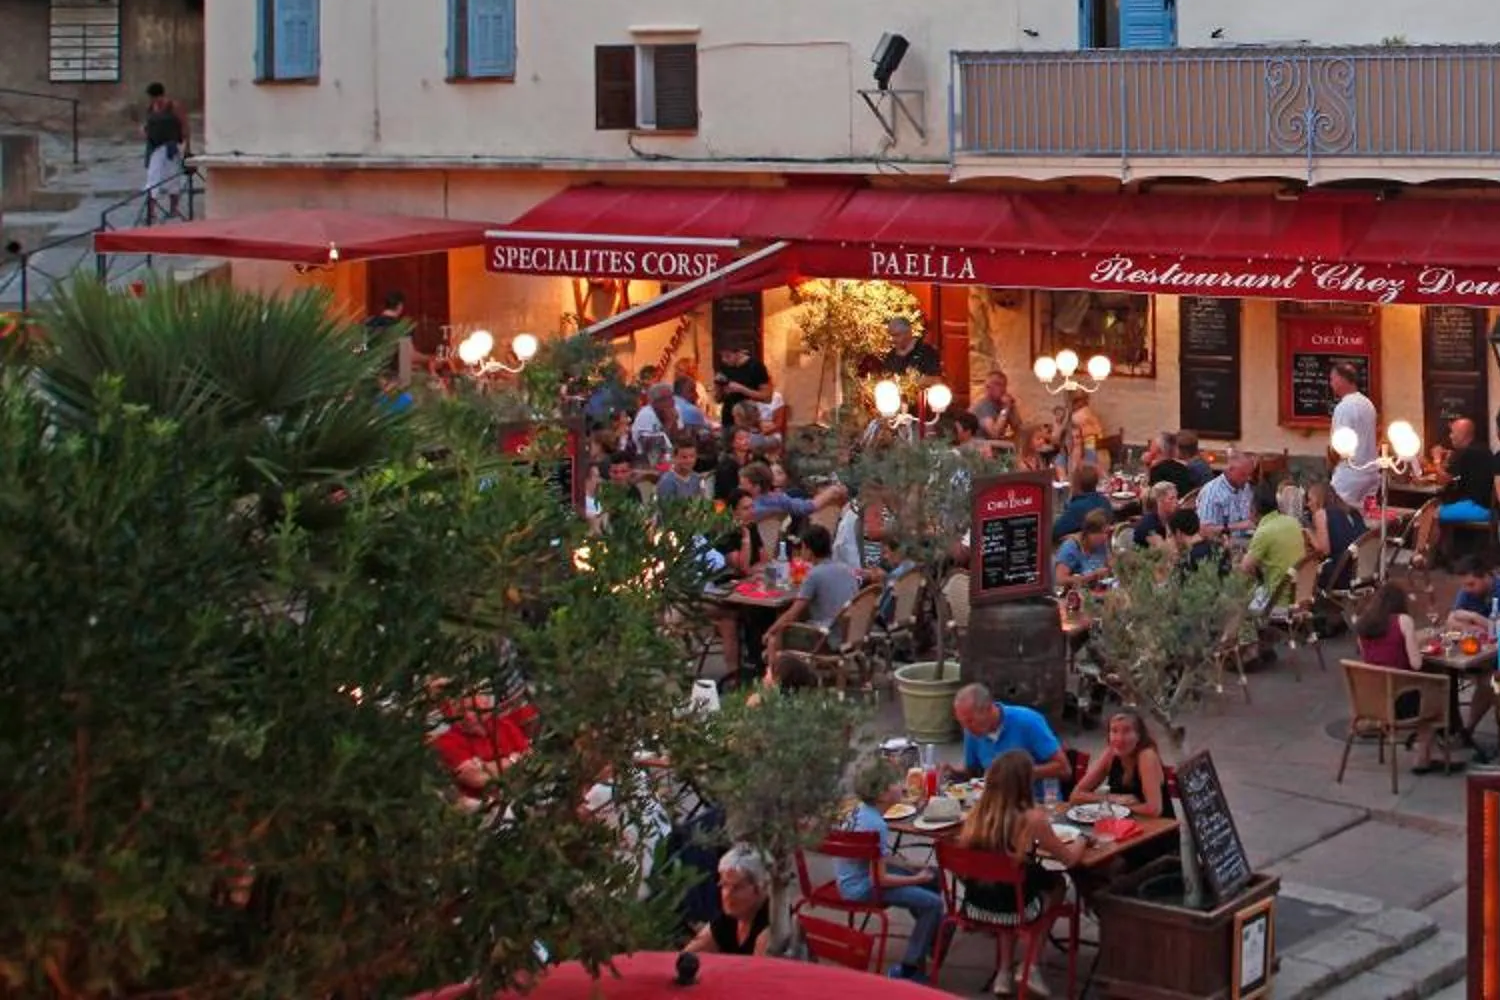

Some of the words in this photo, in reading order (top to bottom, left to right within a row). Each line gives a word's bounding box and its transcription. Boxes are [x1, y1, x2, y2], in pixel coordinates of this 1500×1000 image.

[493, 245, 636, 274] SPECIALITES
[871, 250, 977, 279] PAELLA
[1090, 256, 1304, 289] Restaurant
[1312, 262, 1406, 304] Chez
